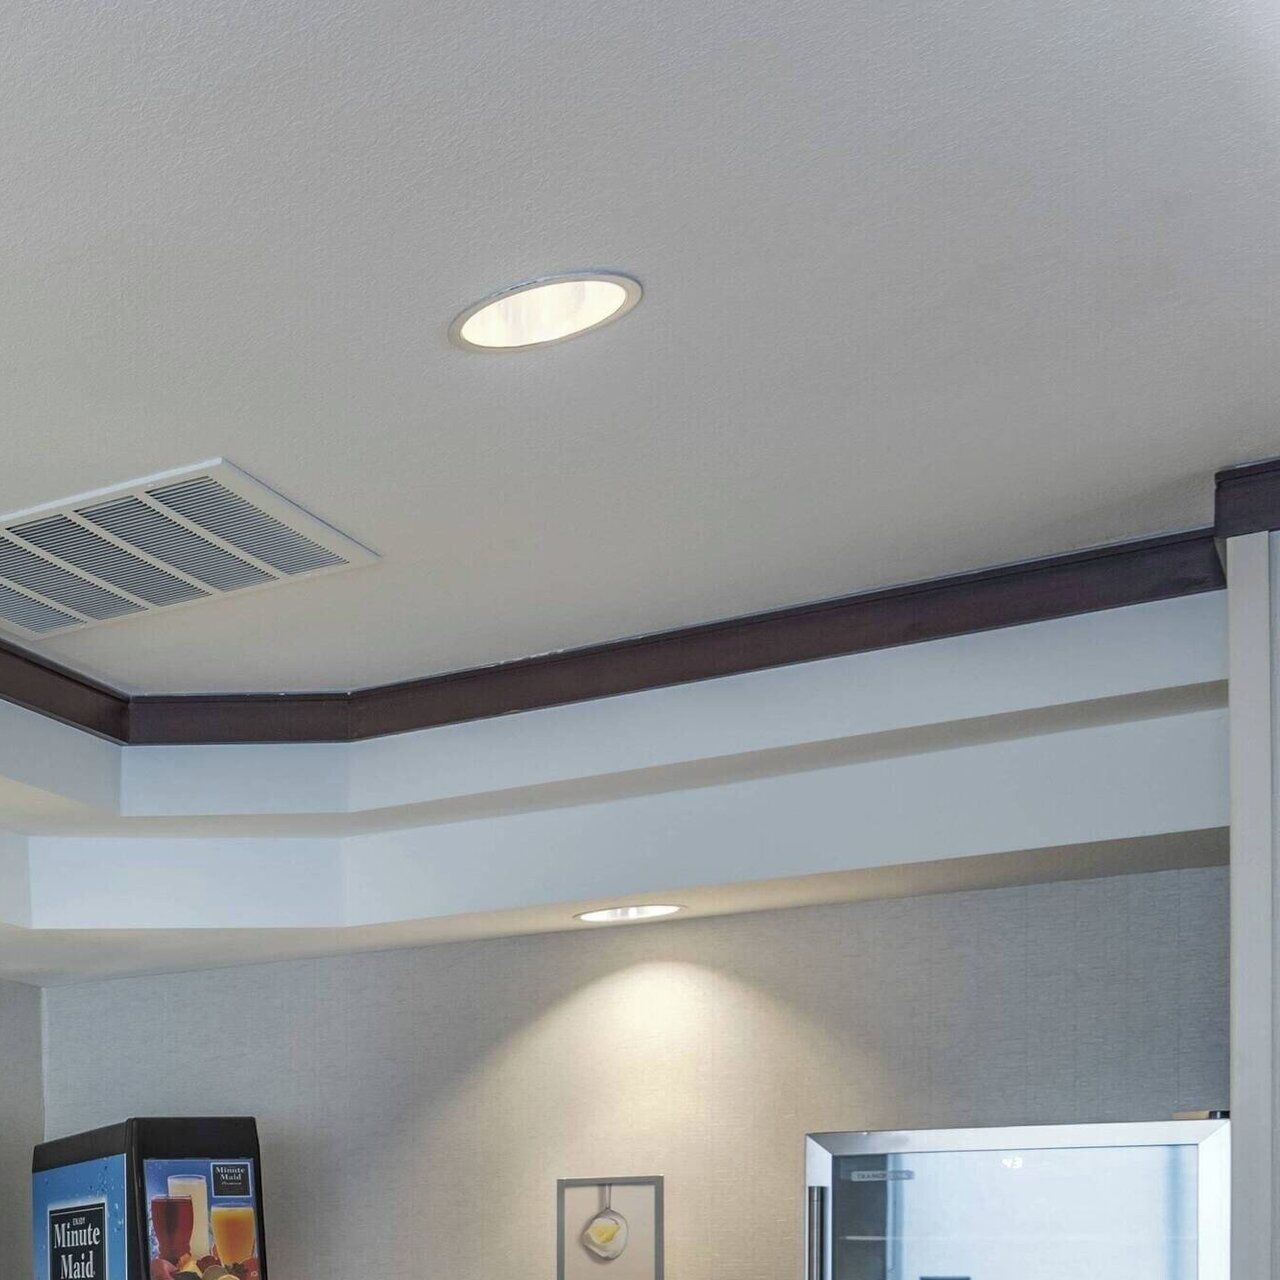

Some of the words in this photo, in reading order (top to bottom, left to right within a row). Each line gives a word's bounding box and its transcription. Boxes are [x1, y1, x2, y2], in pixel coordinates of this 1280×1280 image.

[215, 1166, 246, 1174] Minute
[220, 1173, 242, 1181] Maid
[53, 1221, 101, 1249] Minute
[60, 1250, 95, 1280] Maid
